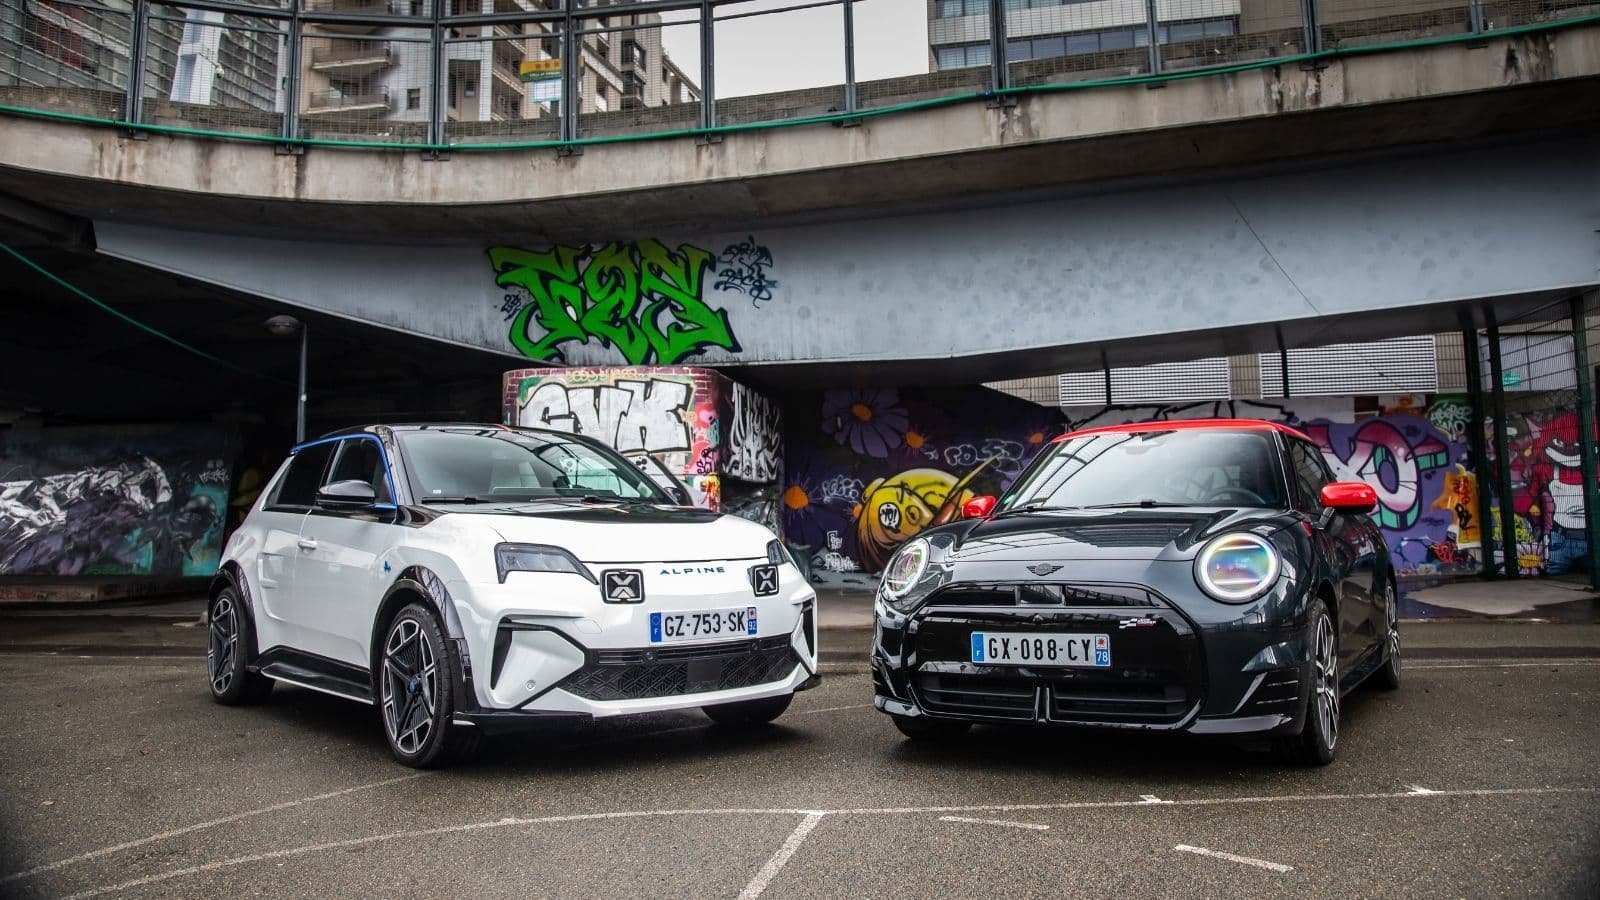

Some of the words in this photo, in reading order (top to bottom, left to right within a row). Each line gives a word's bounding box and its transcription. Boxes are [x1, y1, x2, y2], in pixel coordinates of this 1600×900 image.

[660, 567, 725, 575] ALPINE
[664, 611, 746, 637] GZ-753-SK
[748, 621, 756, 631] 92
[988, 637, 1091, 661] GX-088-CY
[1096, 651, 1108, 663] 78
